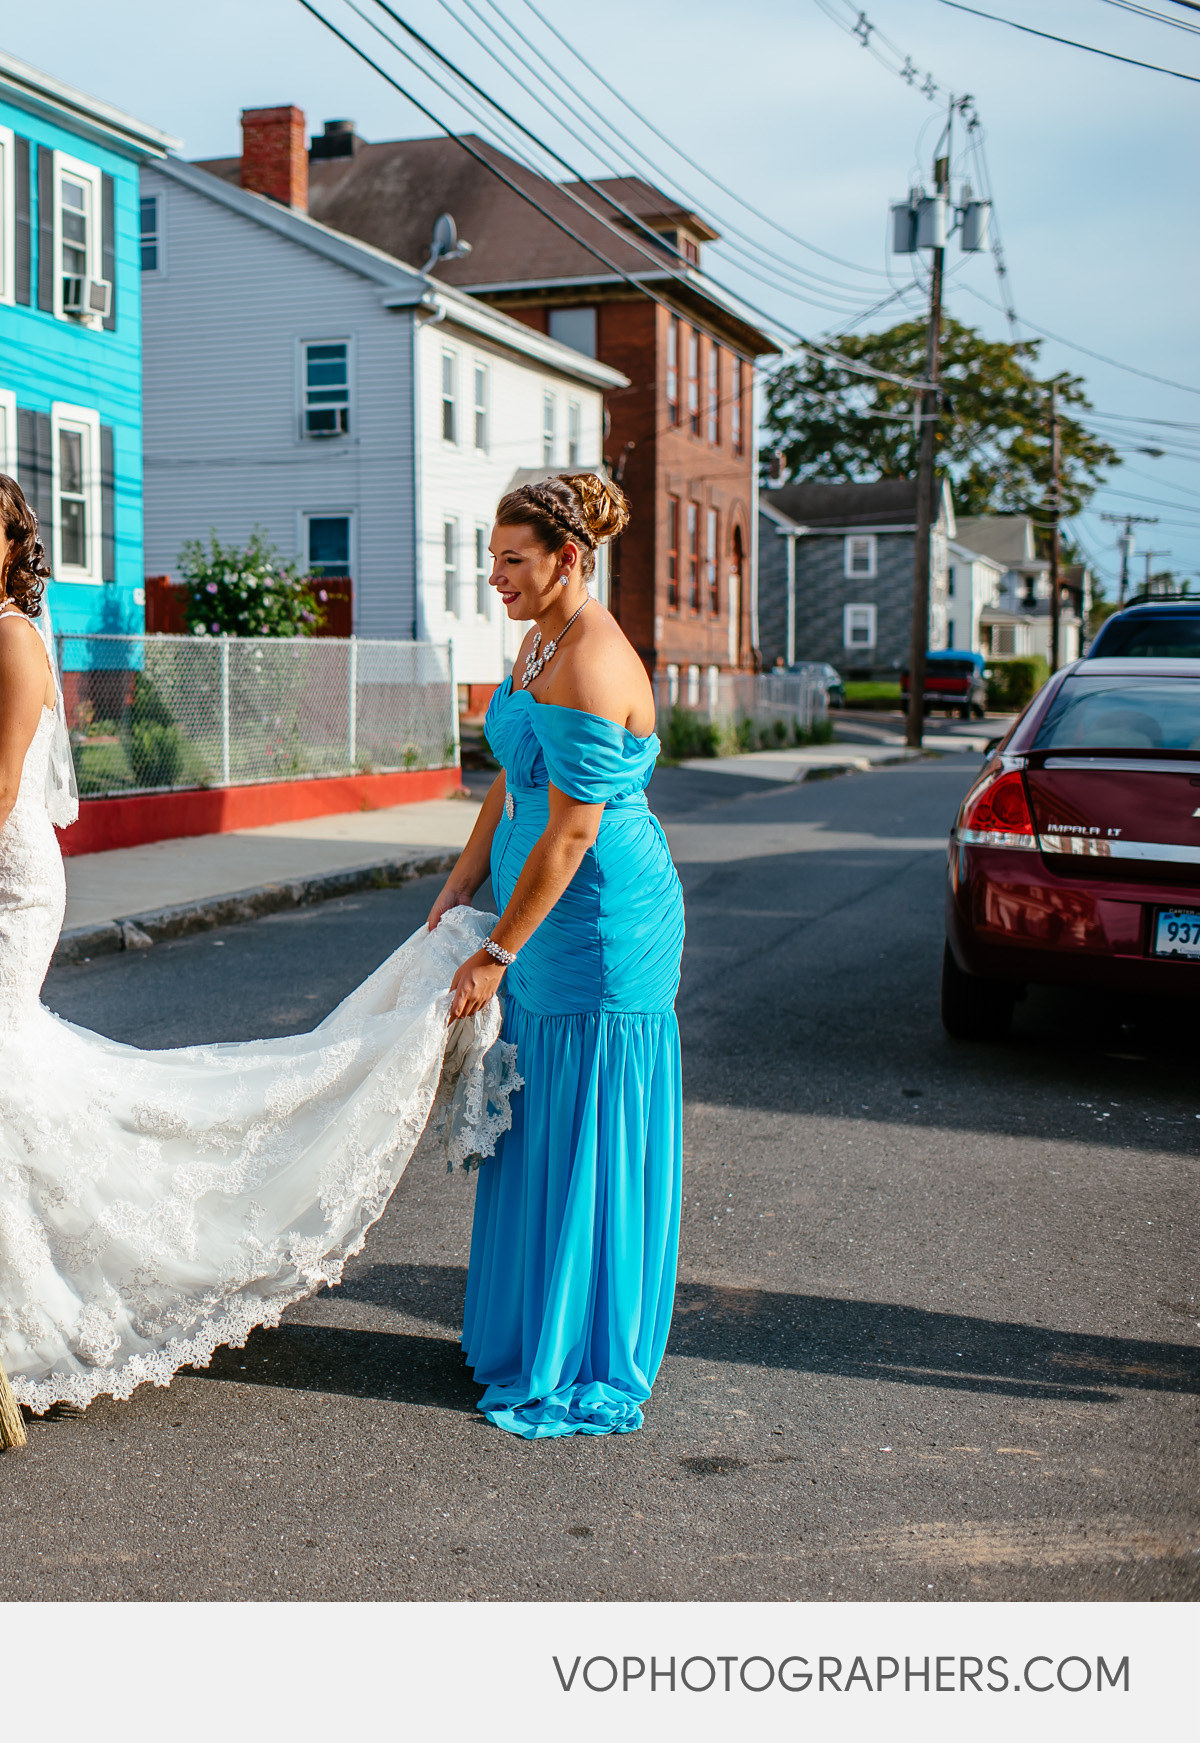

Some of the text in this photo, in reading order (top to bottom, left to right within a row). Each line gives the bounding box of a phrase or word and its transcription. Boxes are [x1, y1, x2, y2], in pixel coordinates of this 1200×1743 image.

[1047, 823, 1122, 837] IMPALA LT
[1167, 921, 1200, 945] 937
